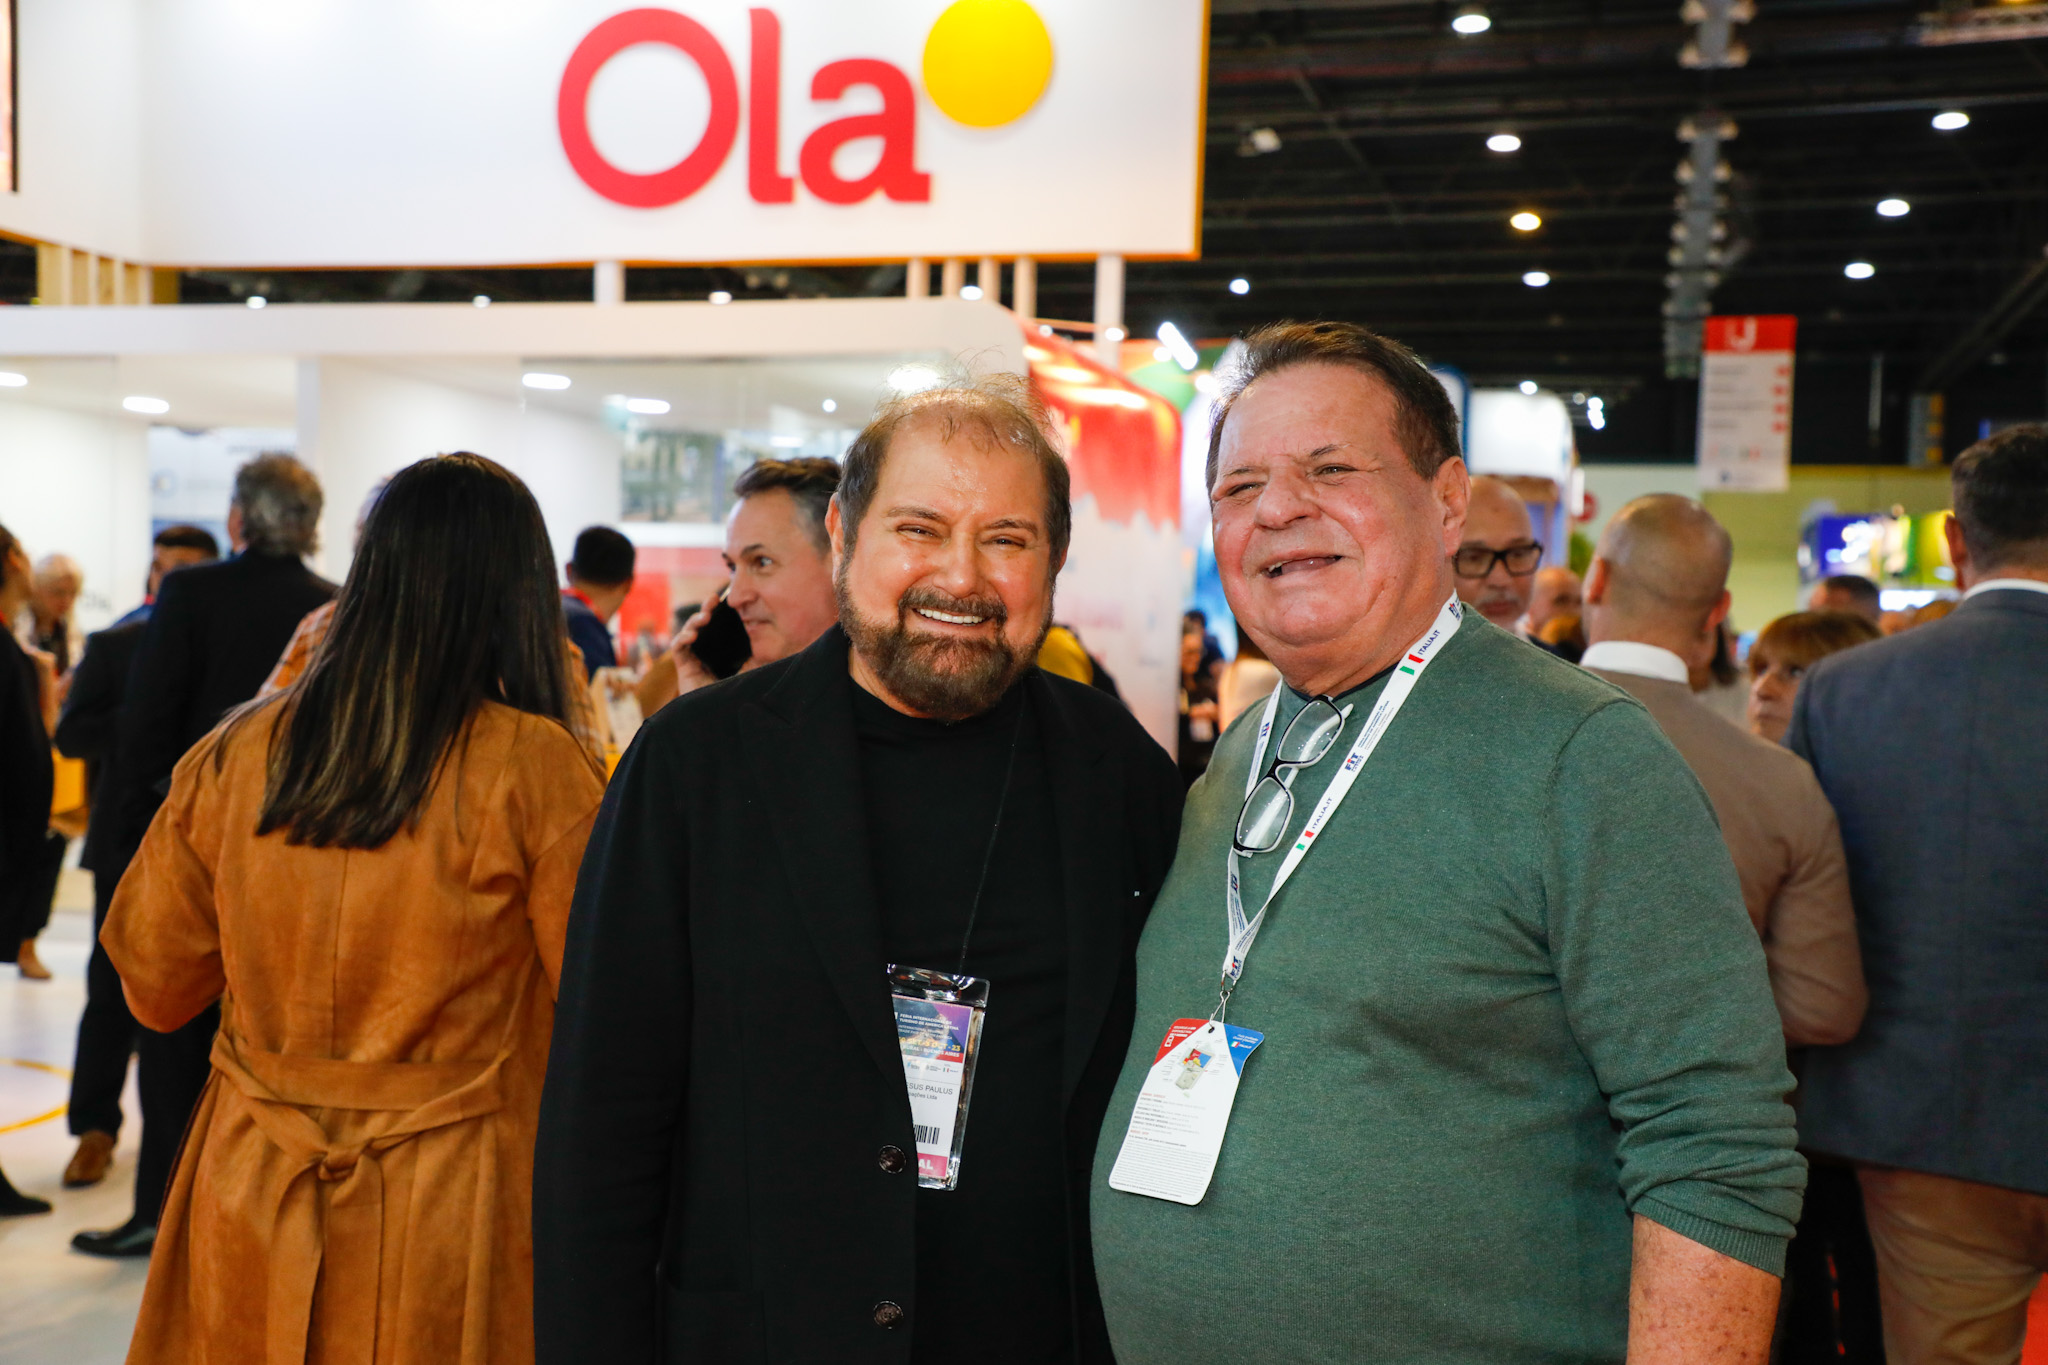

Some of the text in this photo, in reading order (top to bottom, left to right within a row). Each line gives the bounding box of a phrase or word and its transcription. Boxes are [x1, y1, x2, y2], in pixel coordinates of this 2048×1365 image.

[558, 6, 931, 207] Ola
[1418, 630, 1440, 655] ITALIA.IT
[1312, 798, 1332, 829] ITALIA.IT
[926, 1085, 953, 1095] PAULUS
